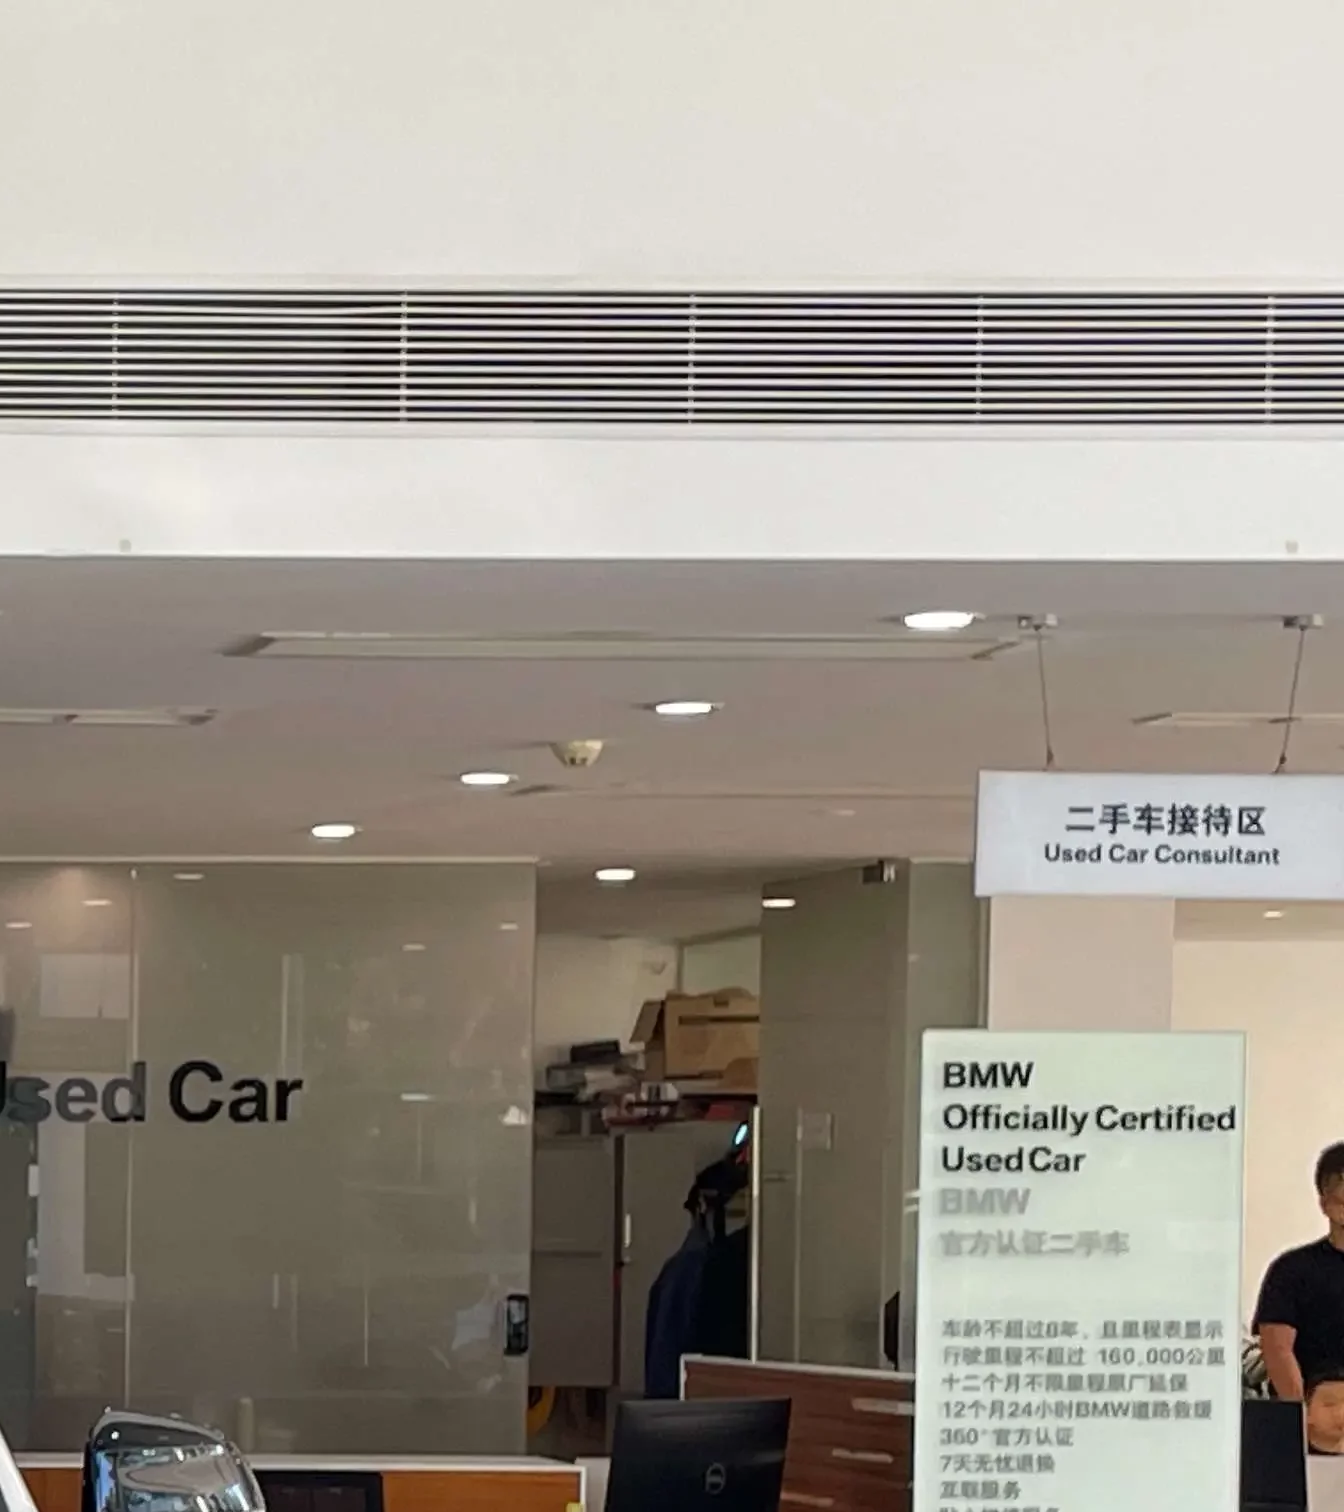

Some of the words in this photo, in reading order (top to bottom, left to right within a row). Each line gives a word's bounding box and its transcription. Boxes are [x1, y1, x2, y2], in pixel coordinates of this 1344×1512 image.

[1065, 802, 1266, 837] 二手车接待区
[1044, 843, 1102, 863] Used
[1109, 843, 1149, 864] Car
[1155, 844, 1280, 866] Consultant
[943, 1061, 1034, 1089] BMW
[169, 1059, 304, 1123] Car
[943, 1103, 1089, 1137] Officially
[1095, 1104, 1236, 1132] Certified
[941, 1146, 1024, 1173] Used
[1028, 1146, 1086, 1173] Car
[937, 1187, 1032, 1217] BMW
[937, 1229, 1131, 1259] 官方认证二手车
